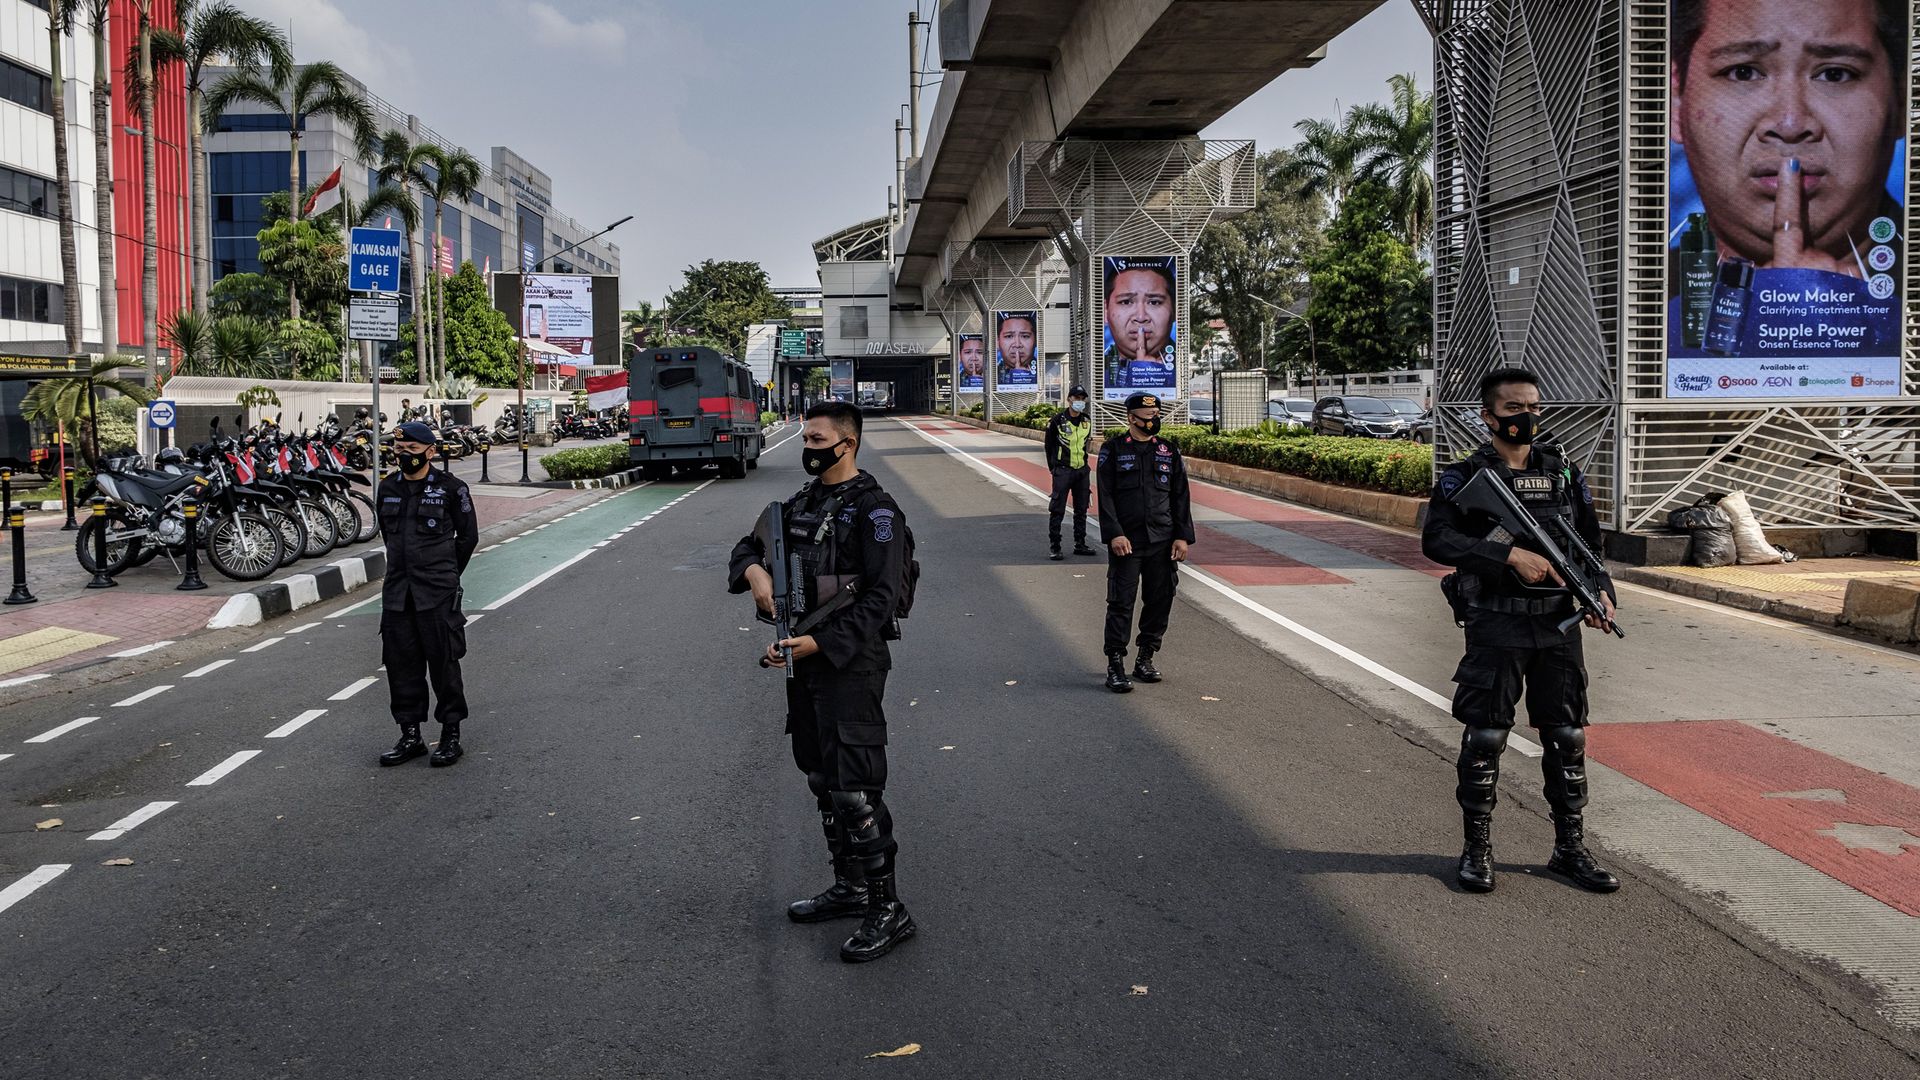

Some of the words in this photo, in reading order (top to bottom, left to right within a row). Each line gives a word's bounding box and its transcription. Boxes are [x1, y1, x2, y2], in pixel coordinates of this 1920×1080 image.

[352, 244, 398, 257] KAWASAN
[360, 264, 389, 276] GAGE
[1686, 271, 1713, 280] Supple
[1760, 290, 1800, 302] Glow
[1805, 289, 1856, 303] Maker
[1719, 297, 1741, 308] Glow
[1716, 306, 1742, 317] Maker
[1759, 306, 1807, 316] Clarifying
[1810, 305, 1860, 314] Treatment
[1862, 305, 1890, 314] Toner
[1759, 324, 1813, 340] Supple
[1818, 324, 1867, 337] Power
[884, 343, 925, 354] ASEAN
[1759, 340, 1790, 349] Onsen
[1793, 340, 1832, 348] Essence
[1833, 339, 1860, 348] Toner
[1732, 378, 1758, 386] SOGO
[1809, 377, 1846, 386] tokopedia
[1865, 377, 1895, 387] Shopee
[1517, 479, 1550, 489] PATRA
